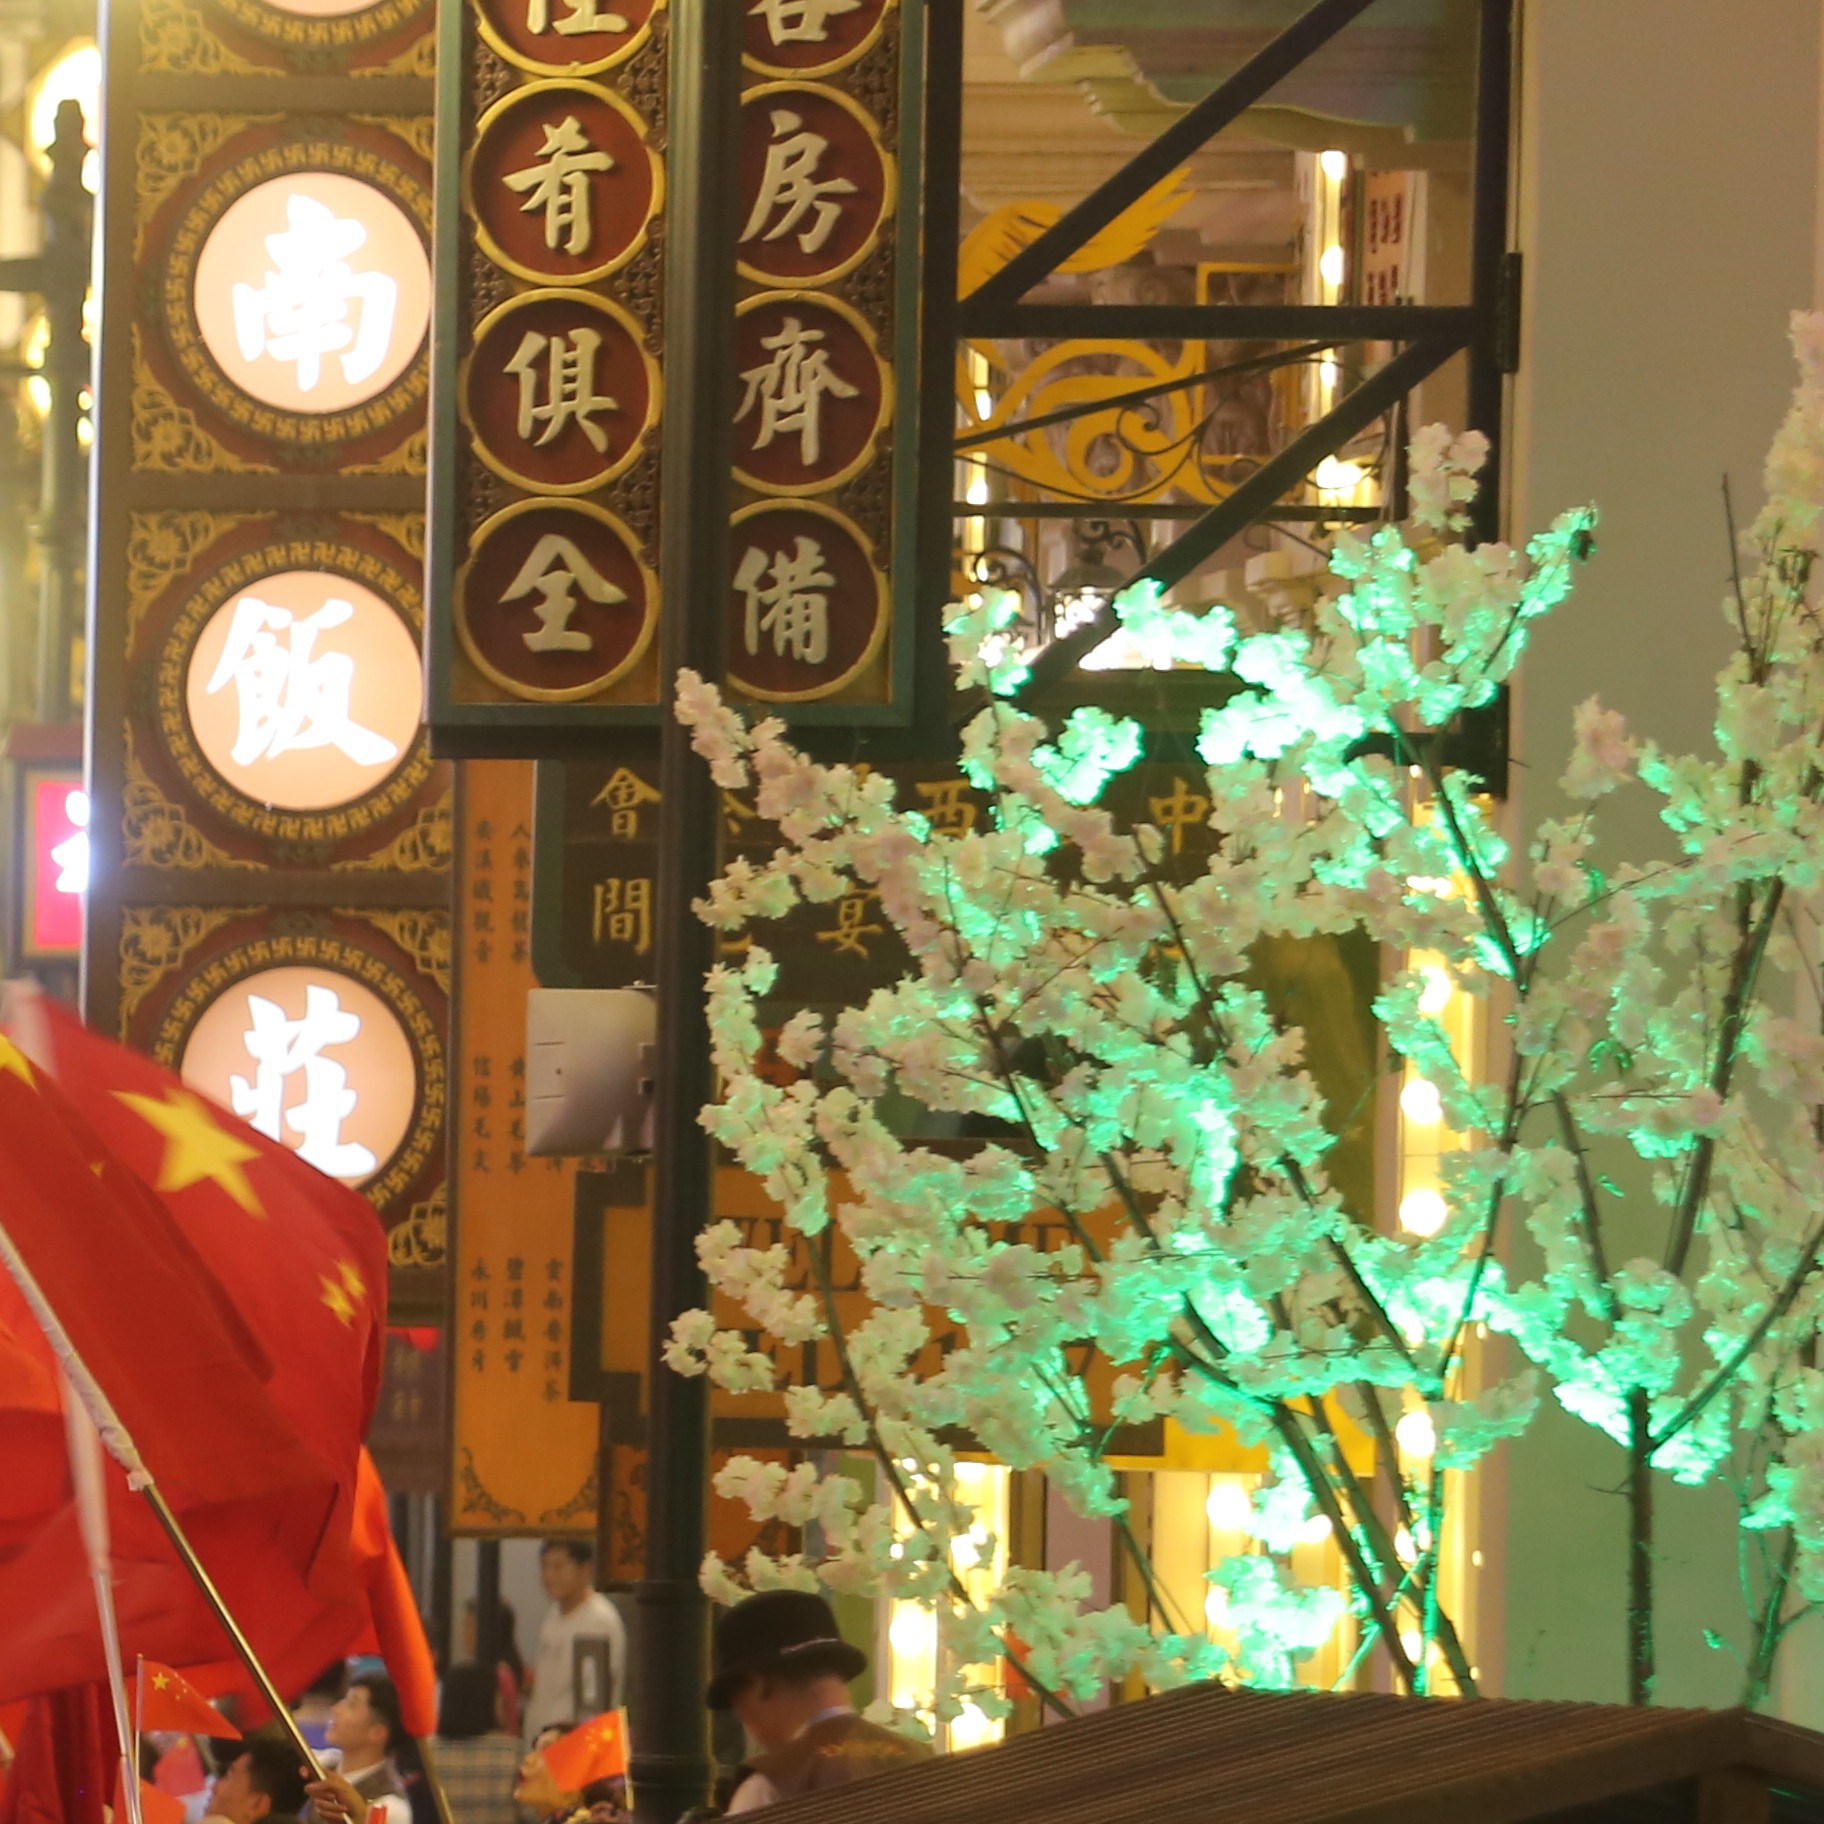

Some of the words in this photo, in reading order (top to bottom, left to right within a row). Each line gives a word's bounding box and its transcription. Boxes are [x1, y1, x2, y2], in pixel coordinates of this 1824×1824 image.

[499, 0, 628, 653] 肴俱全
[733, 0, 862, 667] 房齊備
